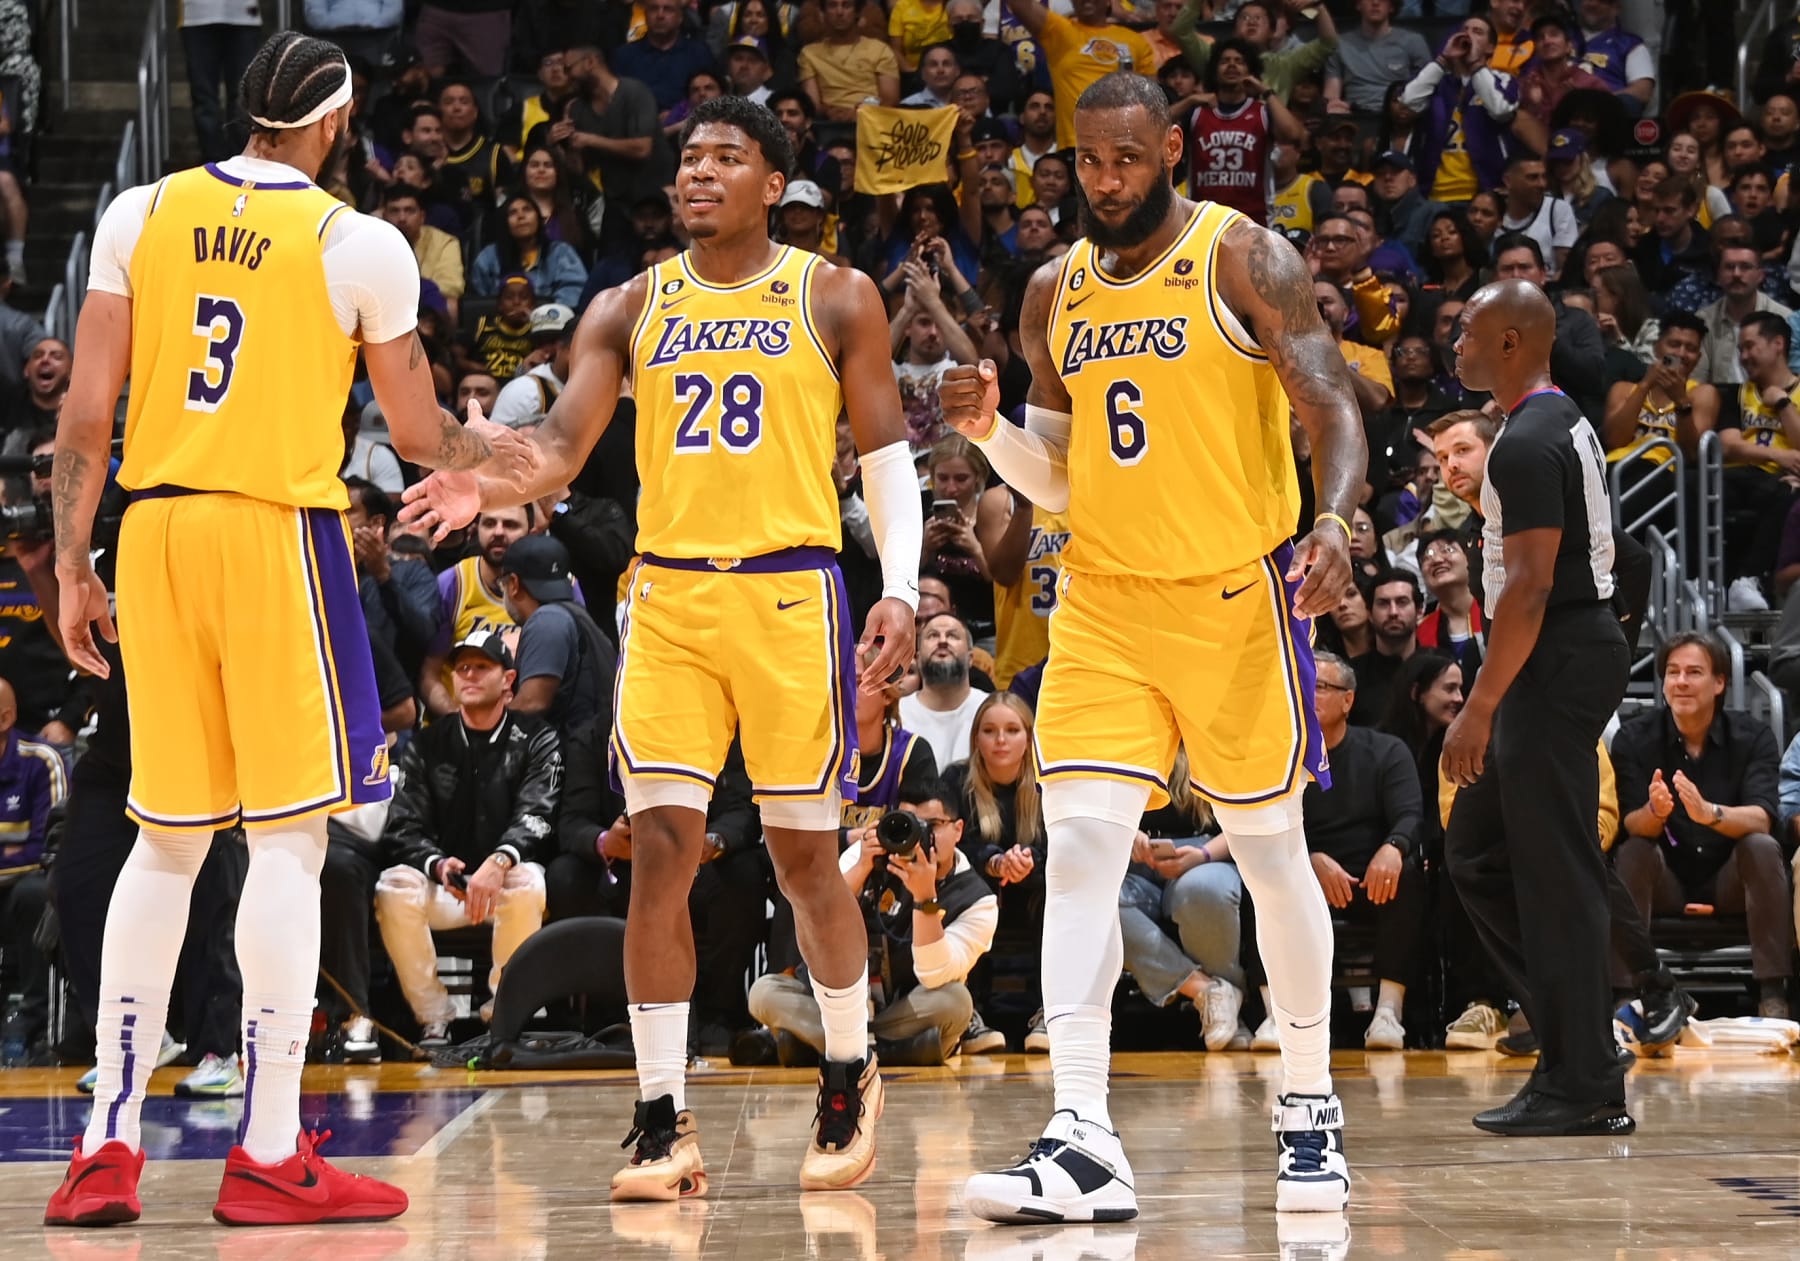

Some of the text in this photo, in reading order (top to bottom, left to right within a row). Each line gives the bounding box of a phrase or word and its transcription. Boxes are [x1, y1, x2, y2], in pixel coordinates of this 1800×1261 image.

[1198, 131, 1257, 152] LOWER
[1209, 148, 1244, 171] 33
[1197, 171, 1257, 188] MERION
[193, 226, 272, 271] DAVIS
[1164, 277, 1199, 290] bibigo
[761, 294, 796, 308] bibigo
[184, 293, 247, 414] 3
[645, 314, 792, 369] LAKERS
[1061, 315, 1190, 379] LAKERS
[673, 371, 764, 455] 28
[1105, 378, 1149, 467] 6
[1315, 1106, 1339, 1126] NIKE
